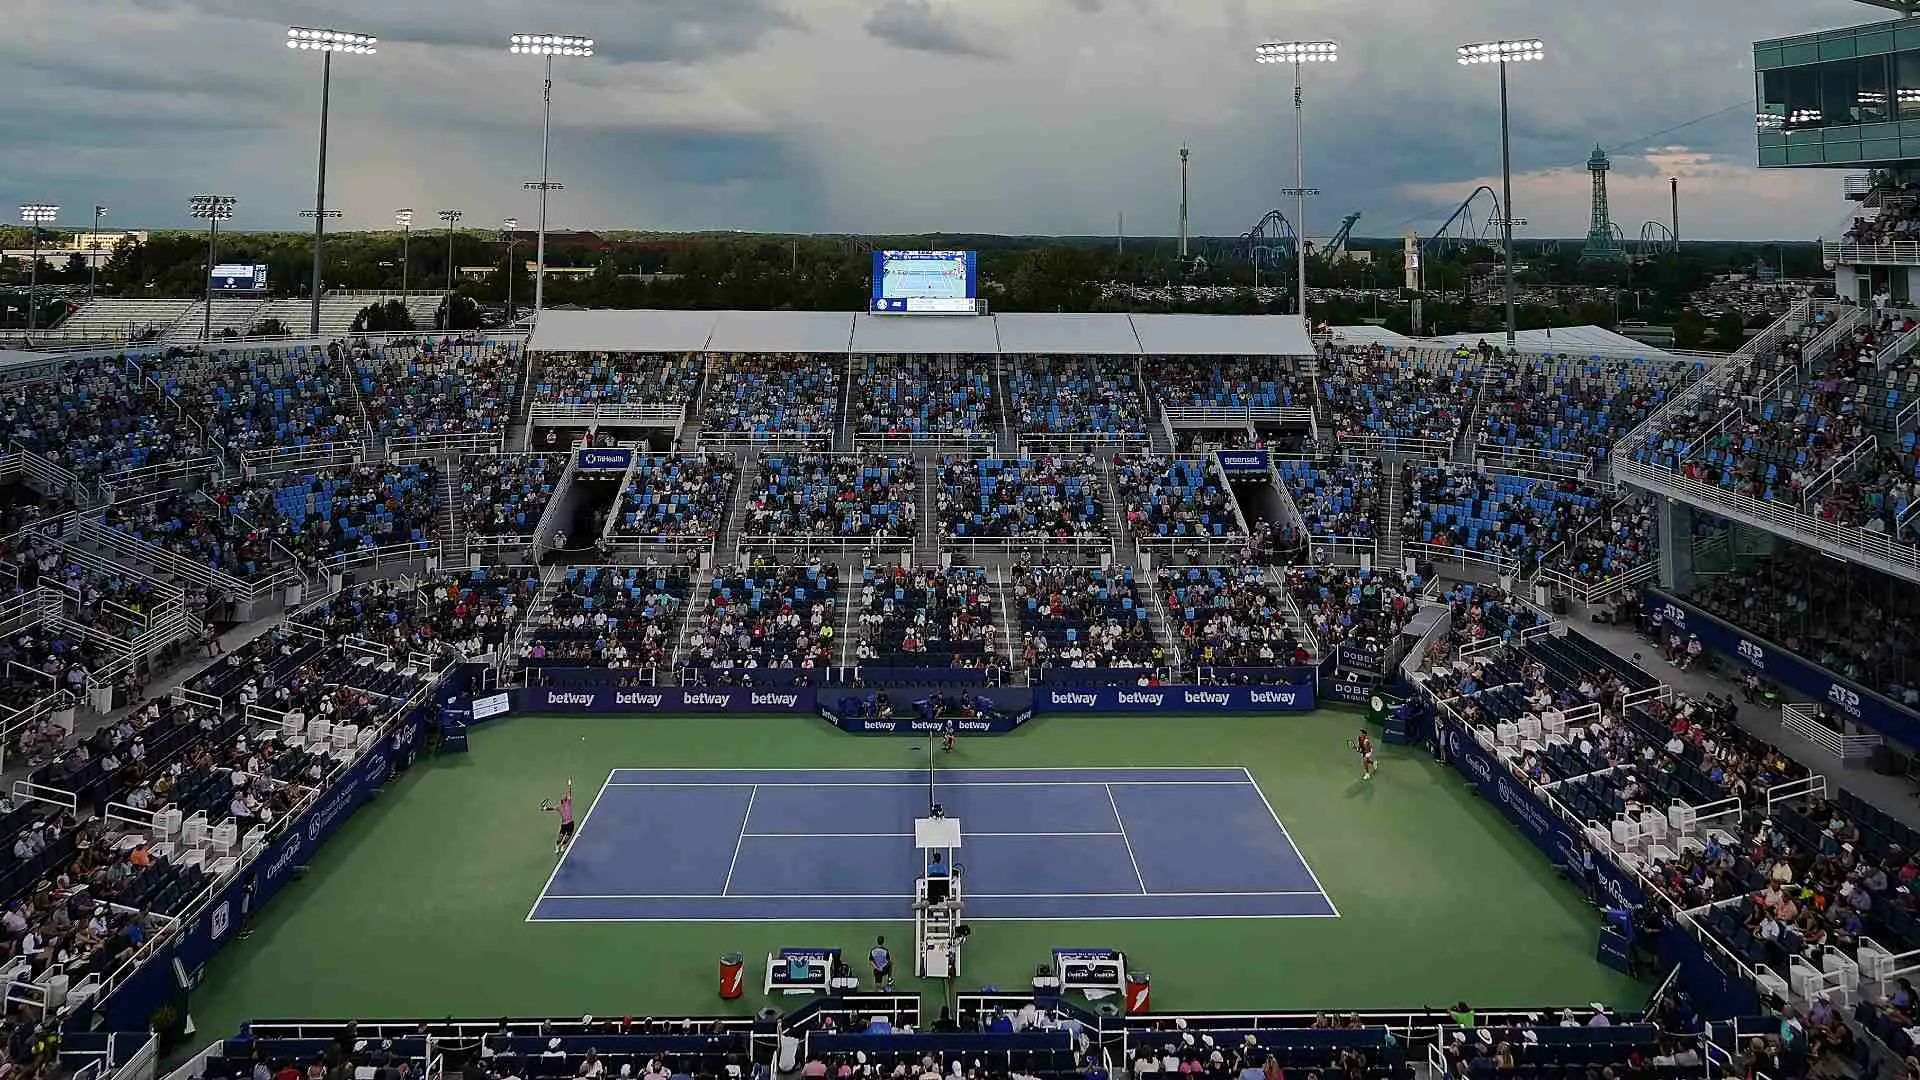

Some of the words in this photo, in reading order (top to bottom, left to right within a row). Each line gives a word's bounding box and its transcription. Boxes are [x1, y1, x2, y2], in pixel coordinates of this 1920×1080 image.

[597, 455, 624, 463] TriHealth
[1737, 640, 1763, 658] ATP
[1335, 683, 1369, 696] DOBE
[1828, 684, 1860, 706] ATP
[548, 691, 595, 707] betway
[615, 691, 662, 707] betway
[683, 691, 730, 707] betway
[751, 691, 798, 707] betway
[1051, 691, 1097, 707] betway
[1118, 691, 1164, 706] betway
[1184, 690, 1230, 706] betway
[1250, 690, 1296, 705] betway
[1342, 693, 1368, 703] TEQUIL
[864, 720, 896, 731] betway
[911, 720, 943, 731] betway
[959, 720, 991, 731] betway
